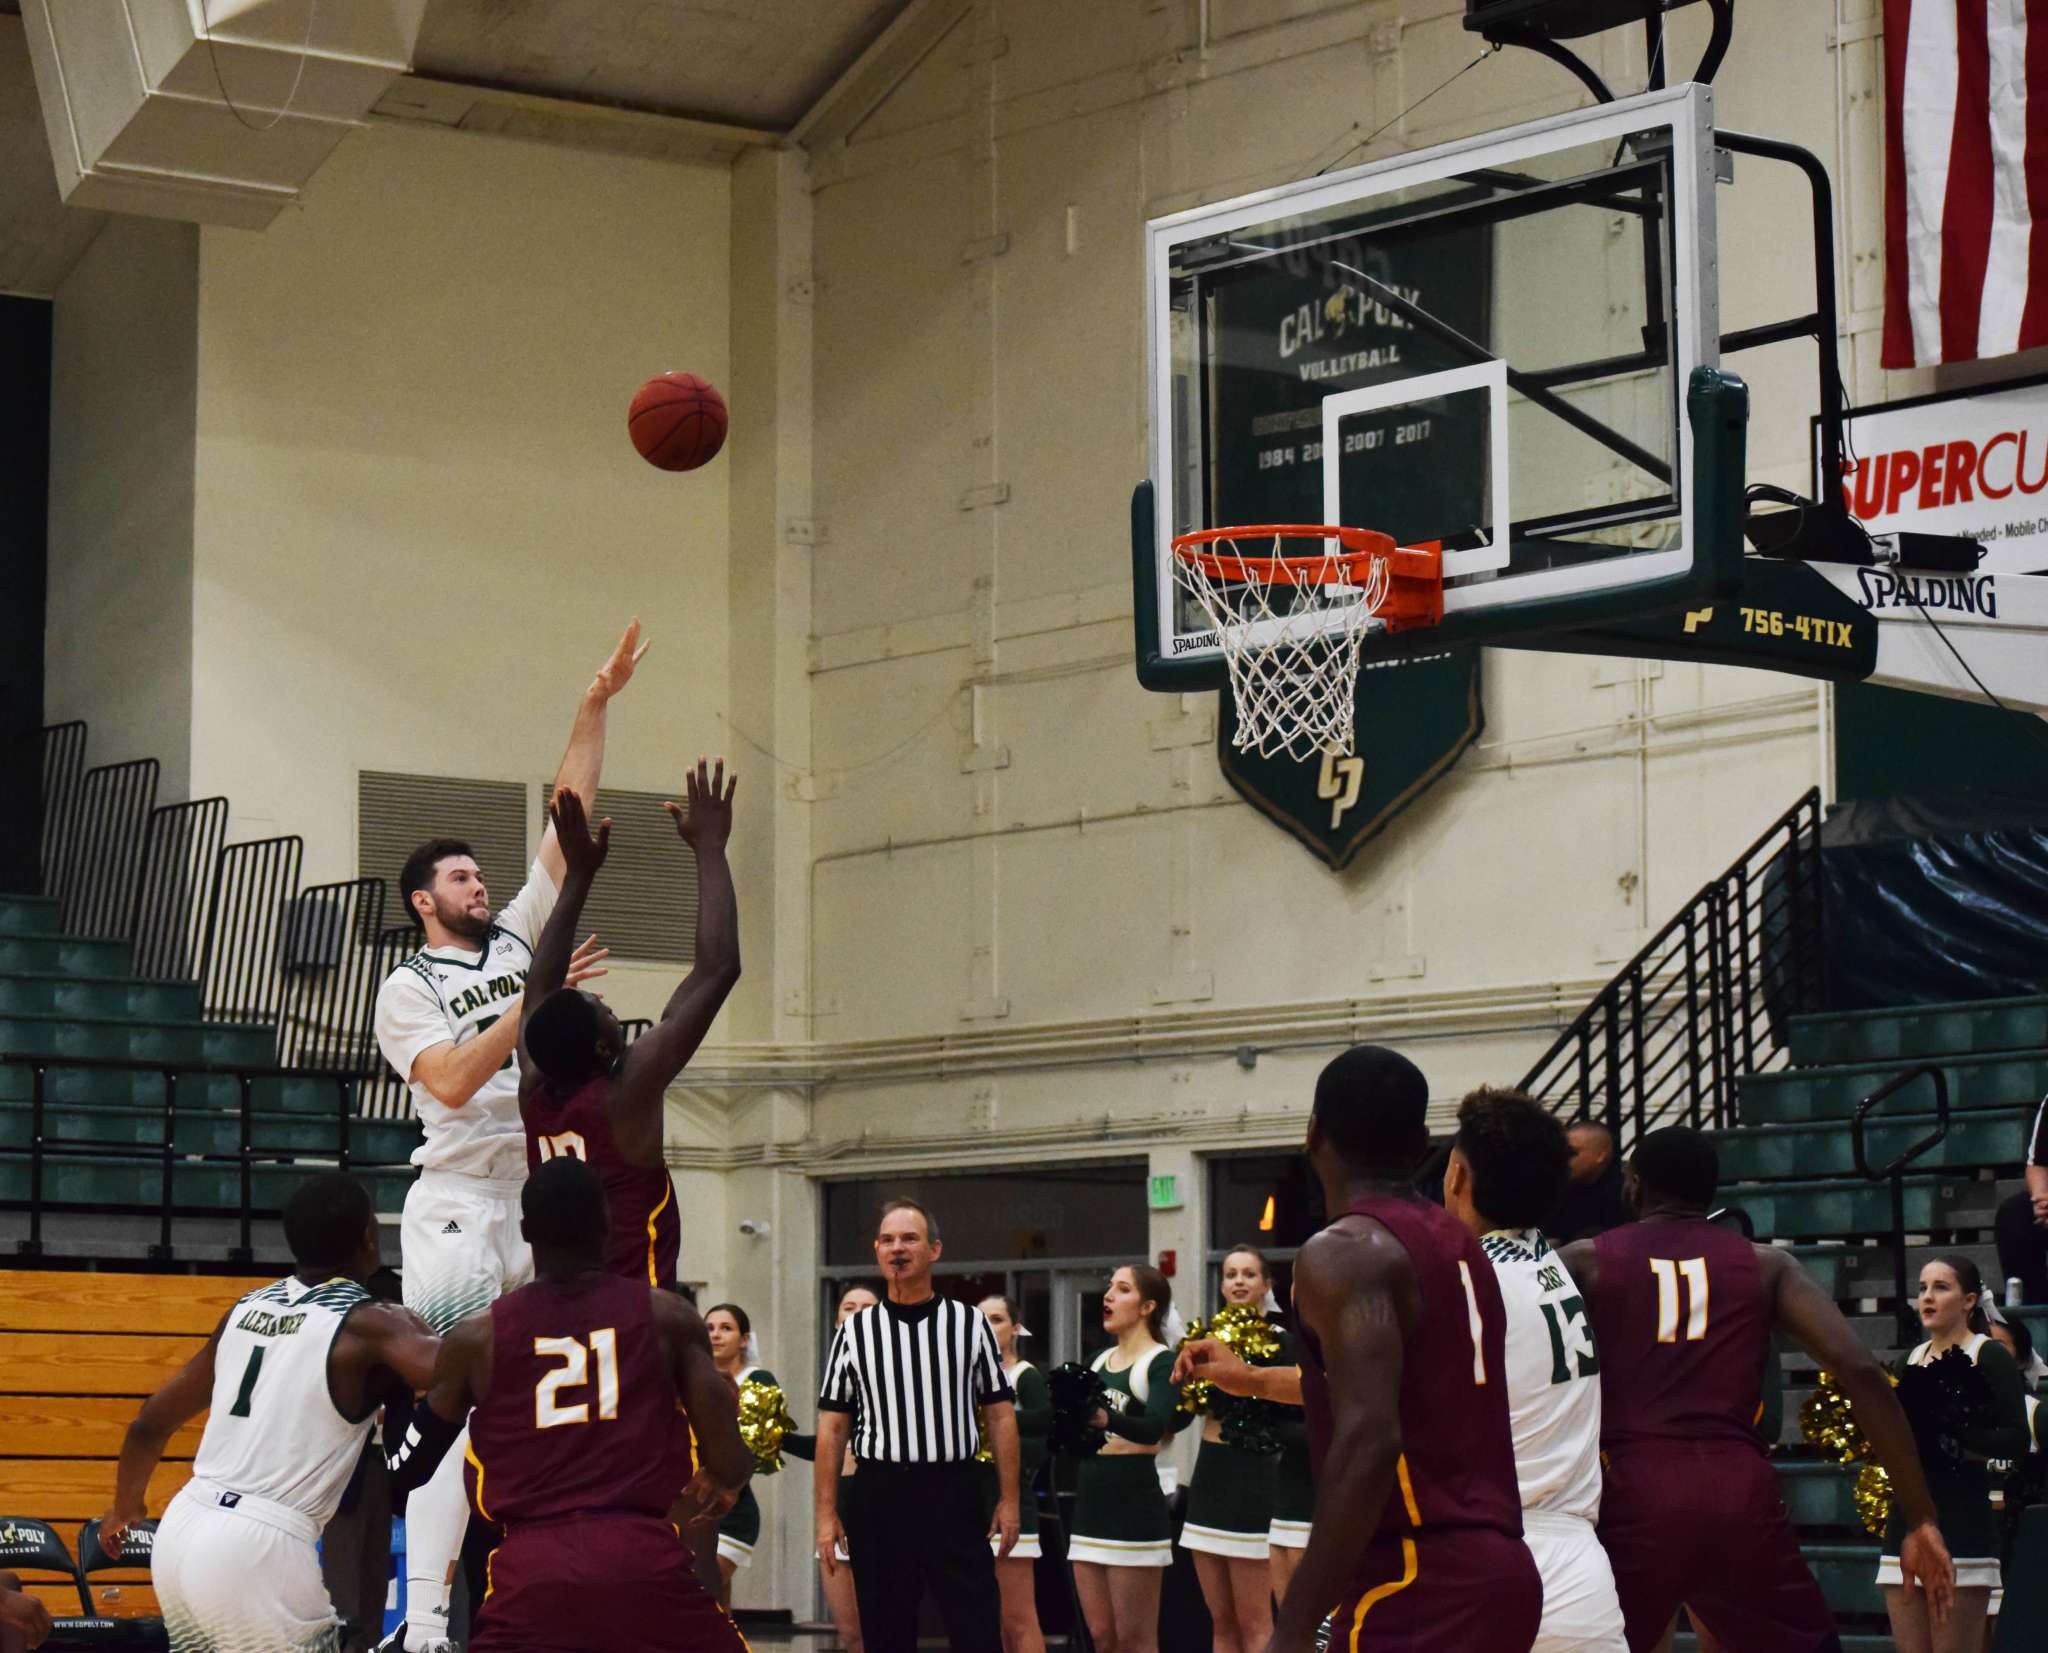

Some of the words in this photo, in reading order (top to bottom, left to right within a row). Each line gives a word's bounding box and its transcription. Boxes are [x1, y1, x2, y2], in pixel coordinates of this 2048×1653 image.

[1280, 300, 1324, 358] CAL
[1299, 345, 1400, 381] VOLLEYBALL
[1259, 448, 1296, 470] 1984
[1345, 429, 1385, 453] 2007
[1395, 420, 1431, 445] 2017
[2006, 520, 2036, 538] Mobile
[1857, 566, 1997, 619] SPALDING
[1173, 632, 1220, 655] SPALDING
[1740, 607, 1853, 648] 756-4TIX
[450, 985, 489, 1019] CAL
[1650, 1257, 1708, 1343] 11
[1539, 1295, 1600, 1385] 13
[230, 1345, 265, 1417] 1
[534, 1328, 619, 1429] 21
[17, 1528, 45, 1544] POLY
